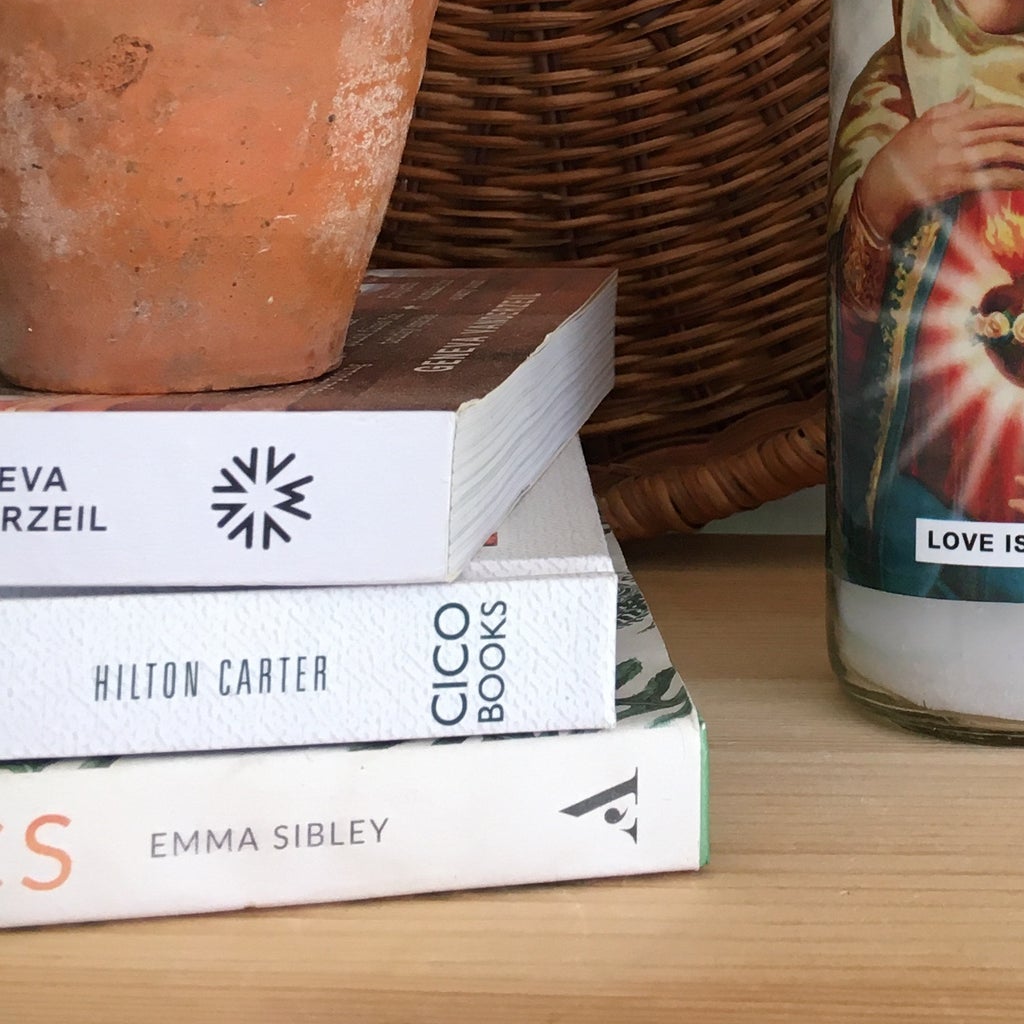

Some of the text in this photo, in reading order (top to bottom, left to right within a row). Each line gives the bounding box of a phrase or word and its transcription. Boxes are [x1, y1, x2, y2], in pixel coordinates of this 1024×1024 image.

[414, 336, 489, 372] GENEVA
[0, 466, 67, 492] EVA
[1, 505, 107, 532] RZEIL
[927, 530, 994, 552] LOVE
[95, 655, 327, 702] HILTON CARTER
[431, 602, 470, 726] CICO
[477, 600, 507, 723] BOOKS
[0, 814, 72, 891] S
[150, 817, 389, 858] EMMA SIBLEY
